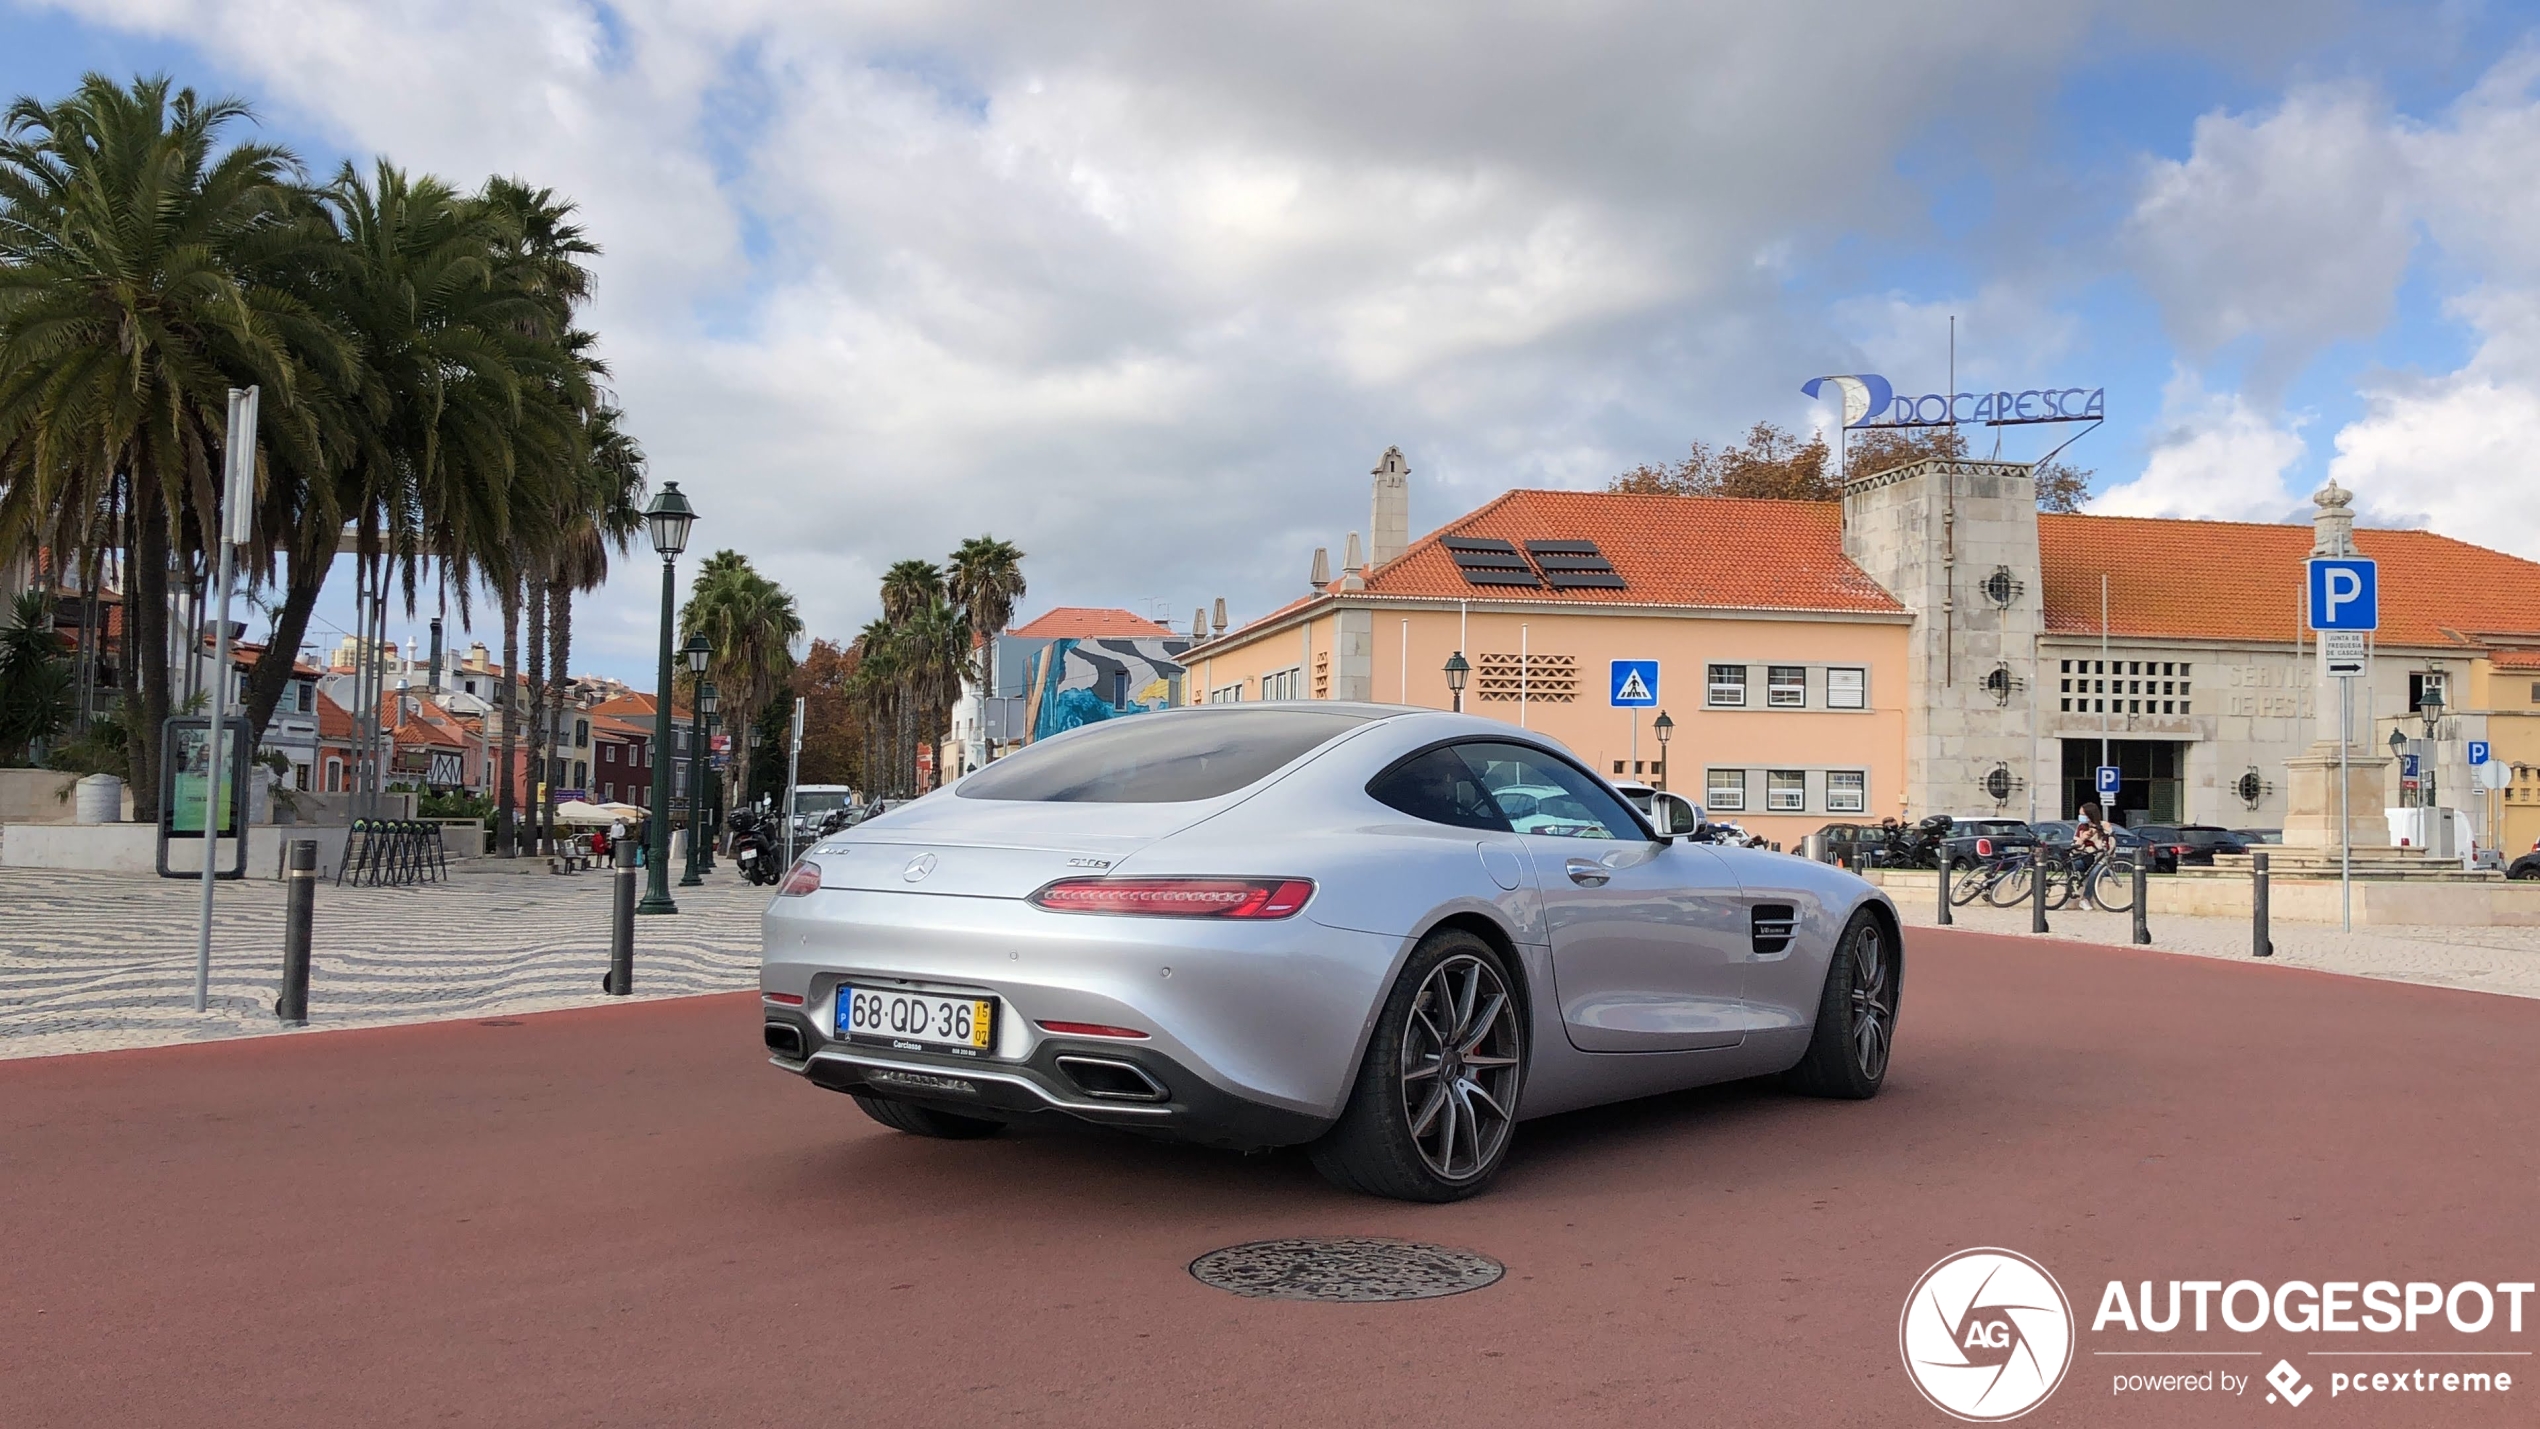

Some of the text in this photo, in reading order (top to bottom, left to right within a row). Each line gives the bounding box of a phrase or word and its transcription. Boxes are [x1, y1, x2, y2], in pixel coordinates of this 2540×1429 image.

[1896, 387, 2105, 424] DOCAPESCA
[2325, 567, 2362, 623] P
[2472, 743, 2485, 763] P
[2101, 769, 2116, 789] P
[976, 1006, 988, 1018] 15
[975, 1030, 987, 1042] 07
